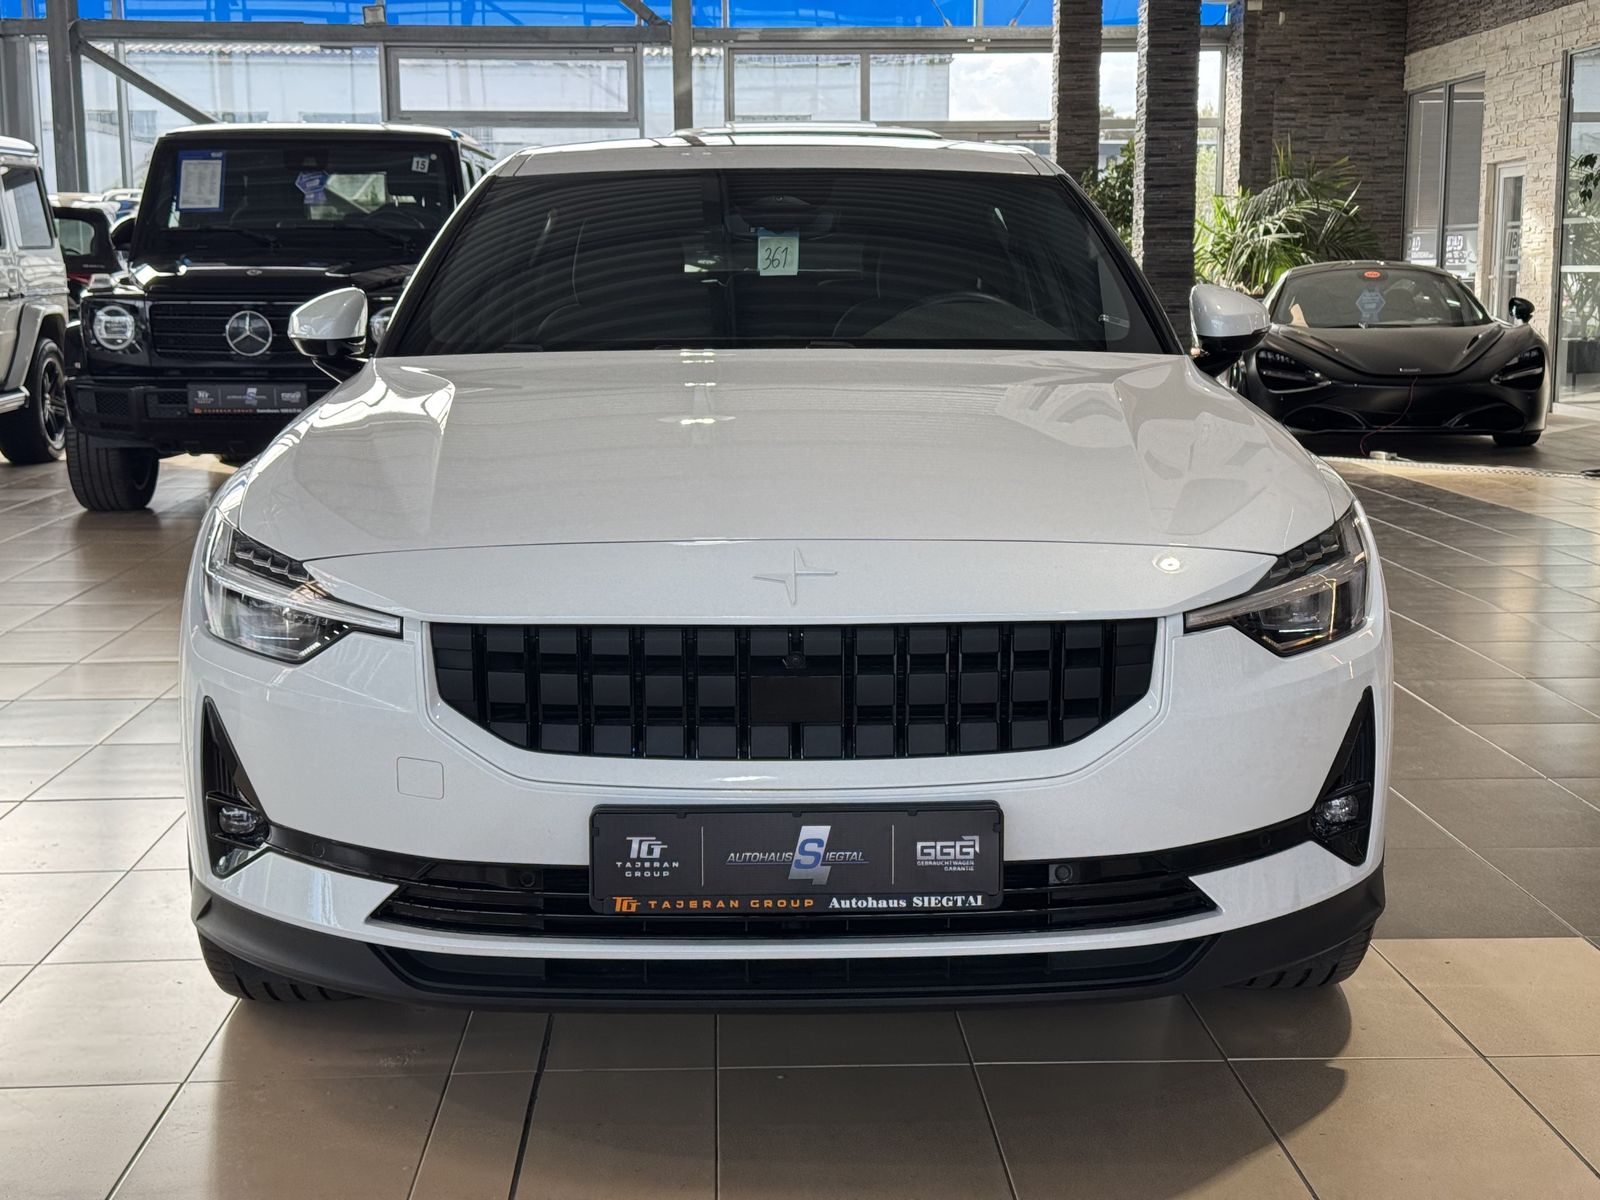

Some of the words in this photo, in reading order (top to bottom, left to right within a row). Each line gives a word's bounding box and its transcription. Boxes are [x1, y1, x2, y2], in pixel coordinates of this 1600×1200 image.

[416, 160, 426, 170] 15
[763, 246, 789, 271] 361
[916, 841, 975, 860] GGG
[726, 852, 793, 863] AUTOHAUS
[648, 900, 739, 909] TAJERAN
[750, 899, 814, 908] GROUP
[829, 896, 907, 909] Autohaus
